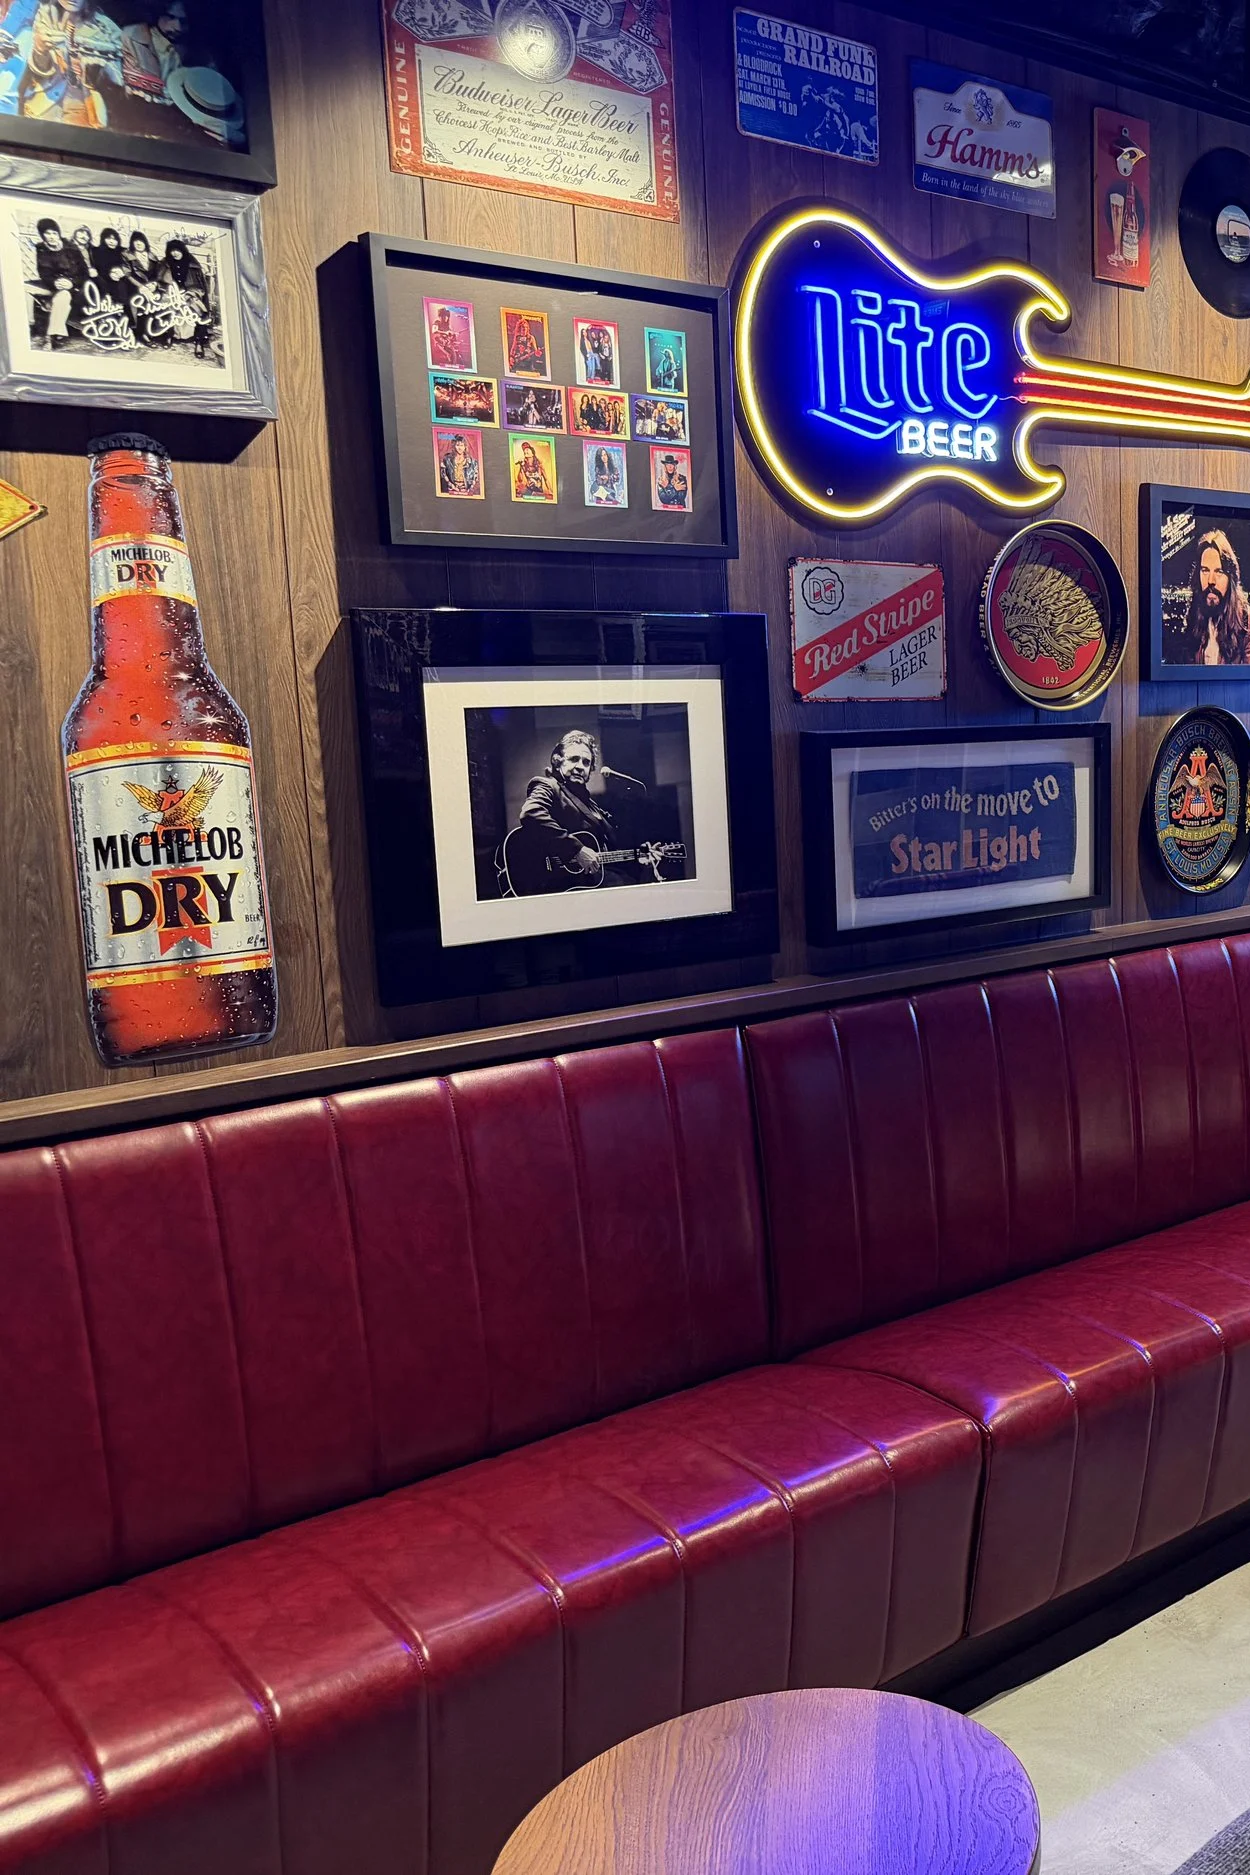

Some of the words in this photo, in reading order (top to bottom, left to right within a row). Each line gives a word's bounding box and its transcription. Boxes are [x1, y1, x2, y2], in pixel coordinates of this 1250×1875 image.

[757, 18, 823, 53] GRAND
[826, 38, 875, 68] FUNK
[743, 55, 782, 77] BLOODROCK
[750, 70, 772, 87] MARCH
[784, 44, 875, 86] RAILROAD
[394, 39, 411, 154] GENUINE
[434, 66, 537, 111] Budweiser
[532, 90, 591, 126] Lager
[589, 100, 639, 134] Beer
[739, 90, 776, 111] ADMISSION
[764, 85, 776, 96] FIELD
[944, 101, 961, 114] Since
[433, 109, 478, 130] Choicest
[531, 135, 553, 146] and
[552, 134, 577, 150] Best
[576, 139, 614, 162] Barley
[613, 147, 641, 164] Malt
[456, 101, 490, 118] Brewed
[493, 112, 505, 123] by
[507, 116, 521, 125] our
[525, 119, 554, 131] original
[557, 126, 584, 138] process
[587, 131, 605, 143] from
[607, 136, 619, 146] the
[498, 138, 525, 147] BREWED
[547, 148, 575, 158] BOTTLED
[660, 102, 673, 204] GENUINE
[924, 124, 1044, 180] Hamm's
[922, 172, 938, 184] Born
[941, 177, 948, 187] in
[950, 179, 961, 190] the
[963, 181, 978, 193] land
[981, 187, 988, 197] of
[988, 188, 998, 197] the
[1000, 190, 1010, 200] sky
[1012, 191, 1024, 202] blue
[800, 284, 998, 440] Lite
[898, 418, 997, 463] BEER
[116, 563, 169, 583] DRY
[809, 576, 836, 605] DG
[803, 629, 860, 679] Red
[861, 588, 936, 645] Stripe
[889, 625, 938, 667] LAGER
[891, 651, 929, 688] BEER
[1208, 727, 1235, 777] BREWING
[868, 795, 917, 832] Bitter's
[921, 791, 940, 810] on
[943, 786, 973, 814] the
[977, 790, 1033, 818] move
[1033, 774, 1060, 807] to
[93, 827, 244, 872] MICHELOB
[1158, 827, 1173, 840] FINE
[1175, 829, 1193, 838] BEER
[1174, 854, 1198, 874] LOUIS
[106, 873, 240, 936] DRY
[245, 913, 260, 922] BEER
